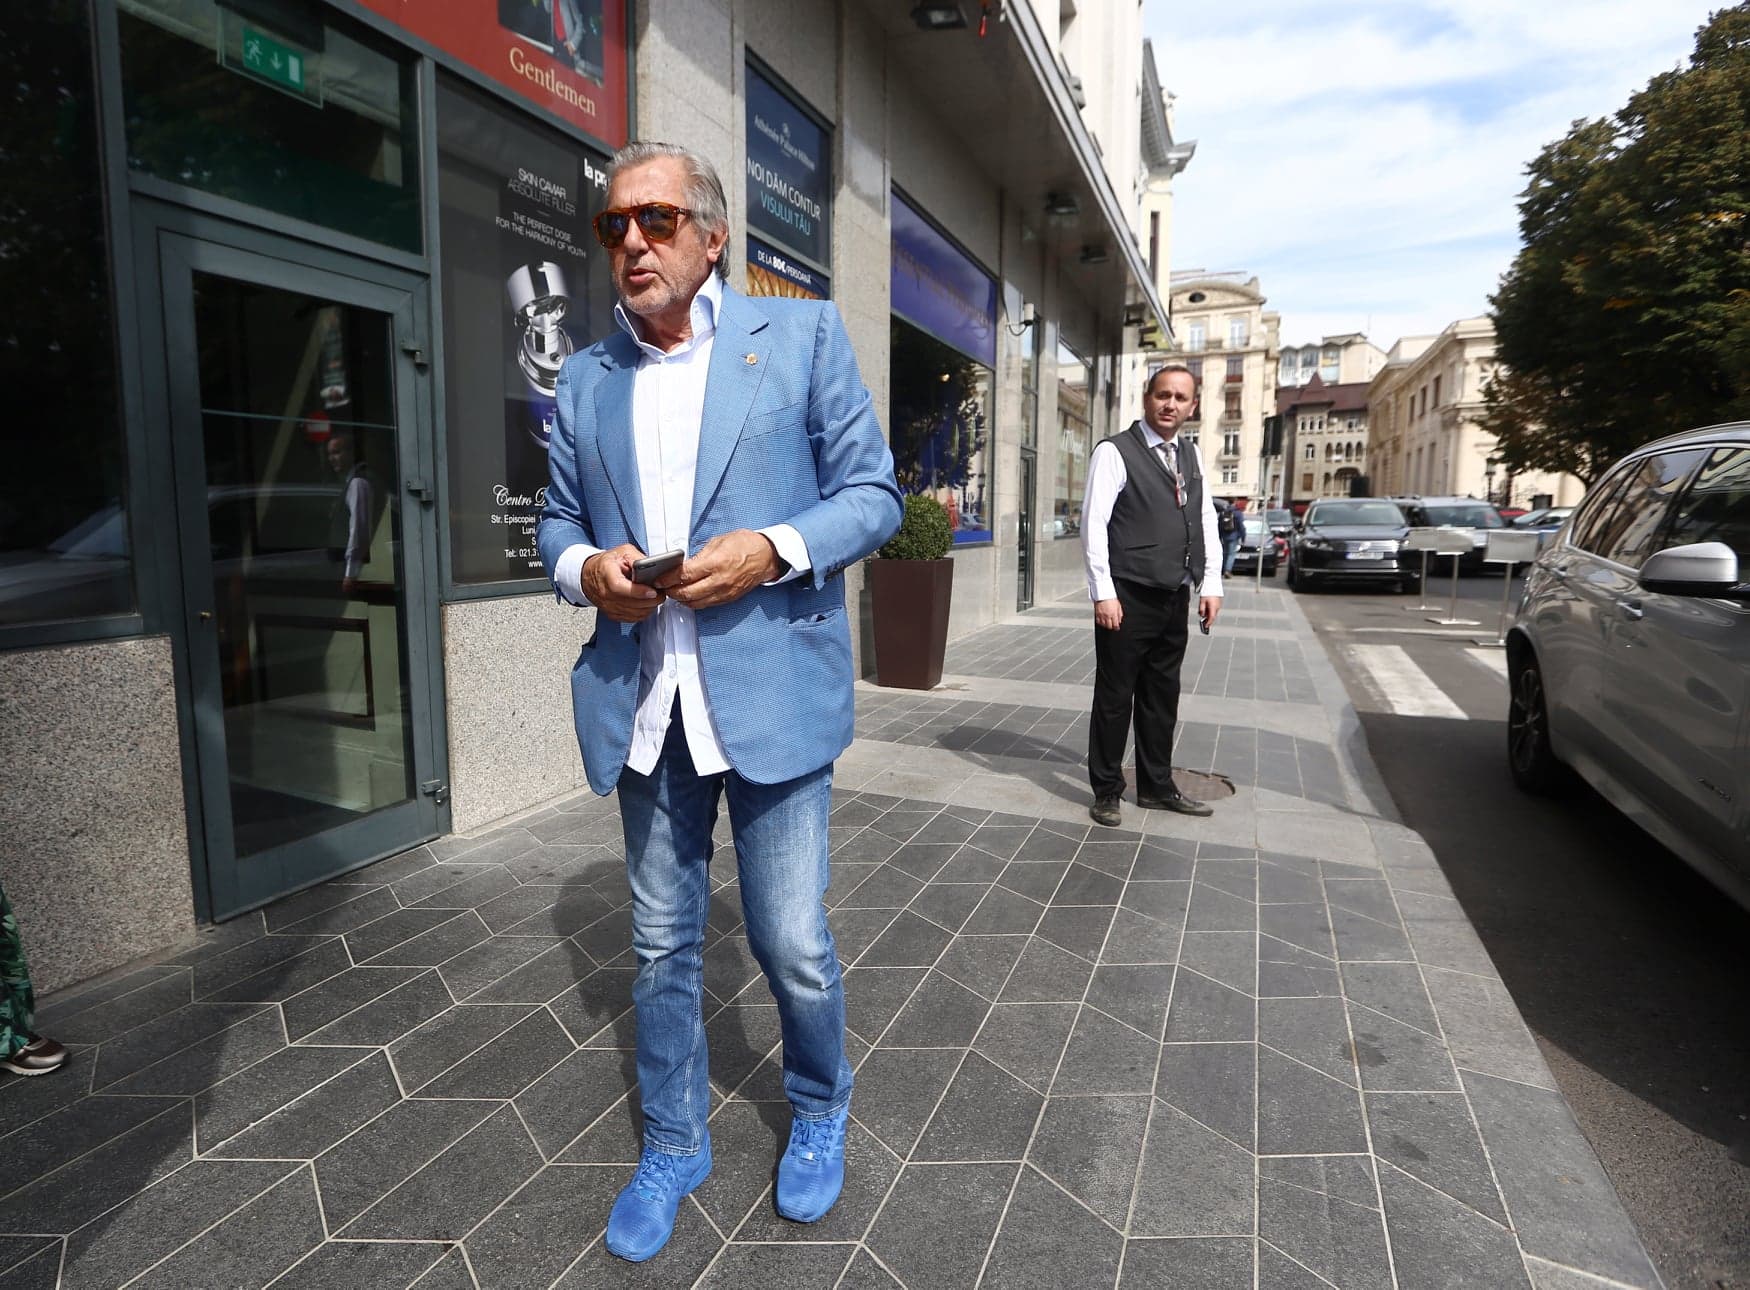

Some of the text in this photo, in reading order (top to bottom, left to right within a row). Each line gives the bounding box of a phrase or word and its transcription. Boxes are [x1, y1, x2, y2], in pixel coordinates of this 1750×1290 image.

[509, 46, 596, 117] Gentlemen
[747, 156, 765, 184] NOI
[788, 186, 822, 221] CONTUR
[760, 191, 794, 225] VISULUI
[492, 484, 532, 506] Centro
